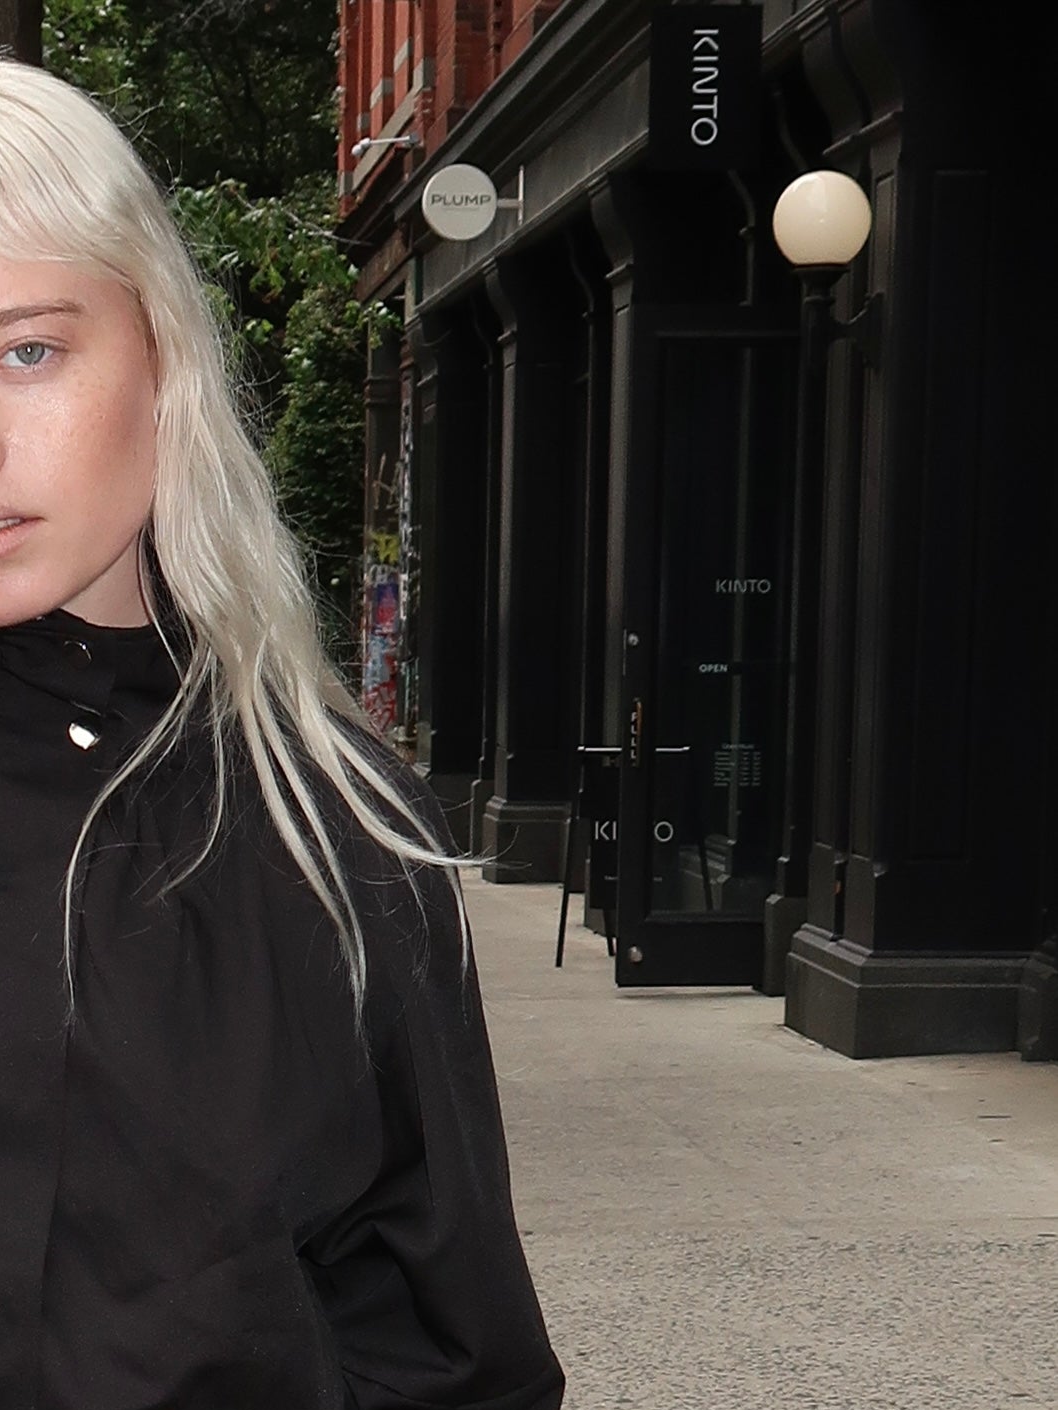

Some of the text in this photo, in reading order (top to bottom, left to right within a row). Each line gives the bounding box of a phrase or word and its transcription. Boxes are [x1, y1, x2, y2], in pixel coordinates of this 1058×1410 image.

[691, 29, 719, 146] KINTO
[431, 194, 491, 206] PLUMP
[715, 579, 771, 594] KINTO
[698, 664, 728, 672] OPEN
[594, 820, 674, 842] KIO
